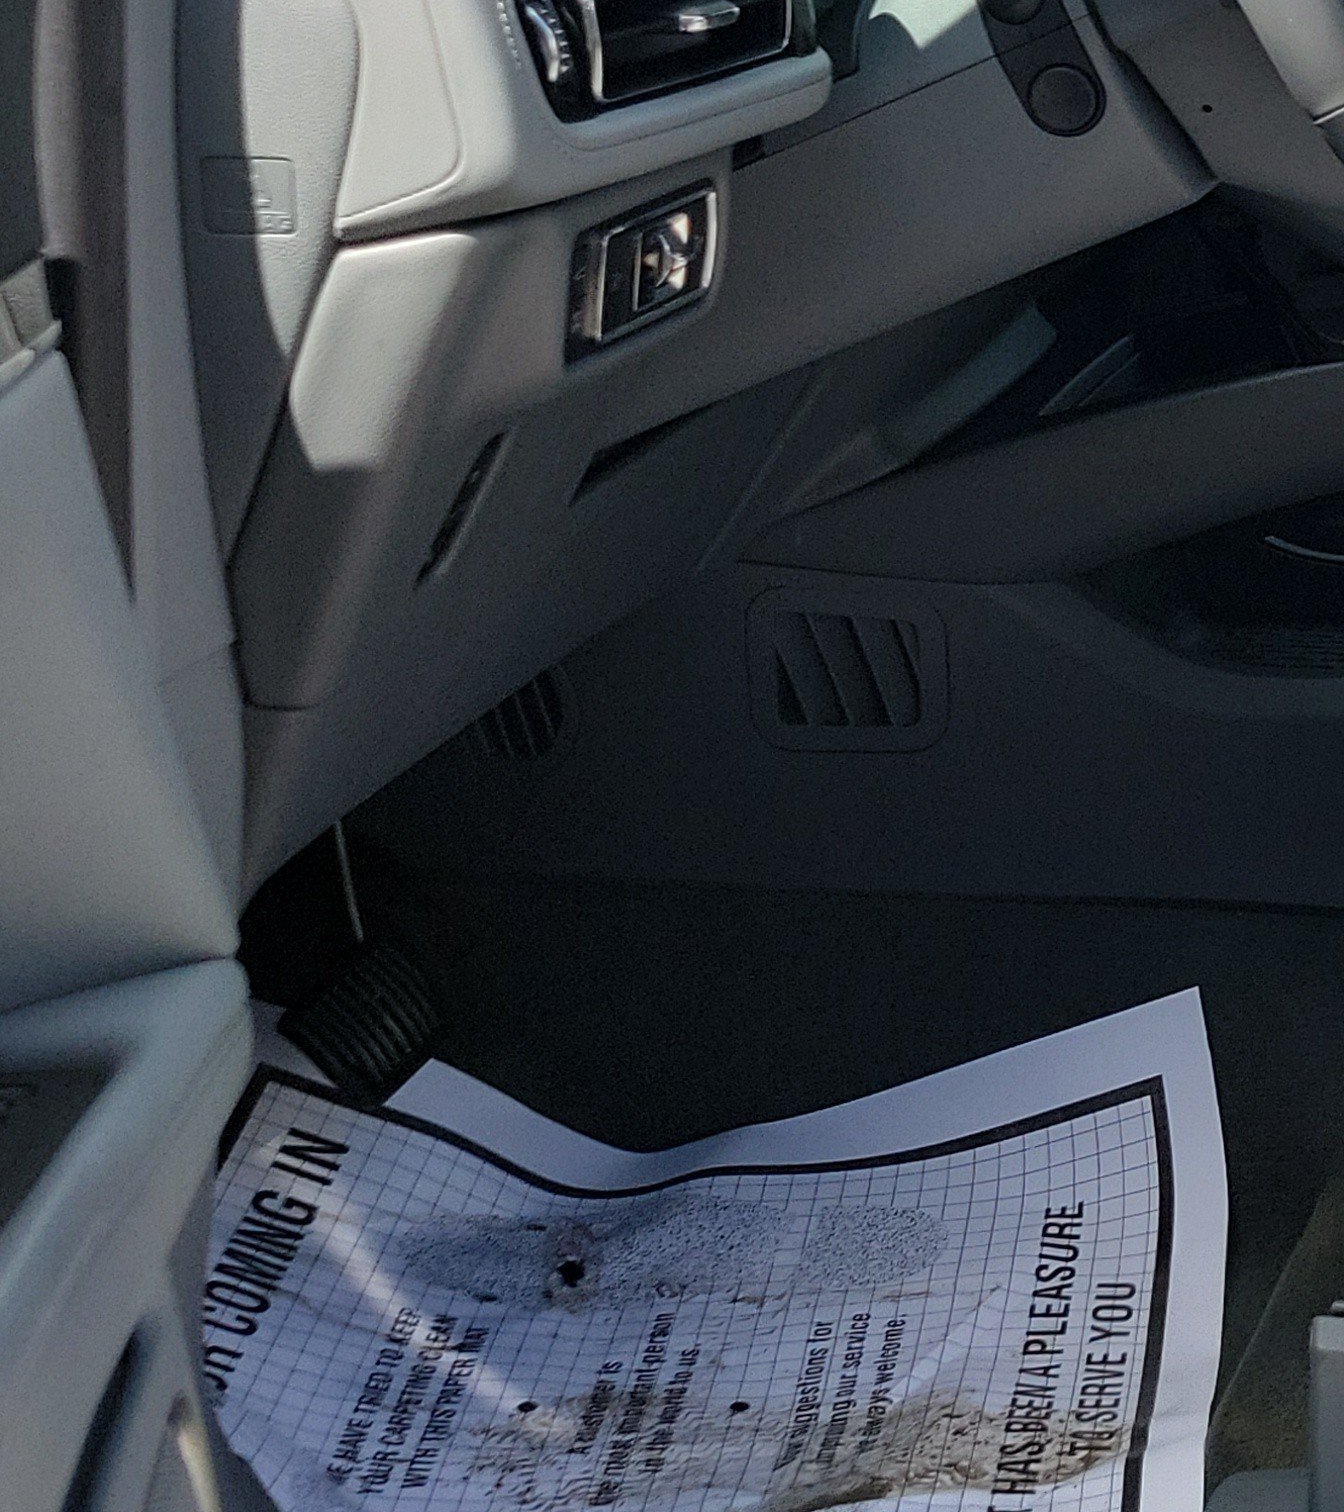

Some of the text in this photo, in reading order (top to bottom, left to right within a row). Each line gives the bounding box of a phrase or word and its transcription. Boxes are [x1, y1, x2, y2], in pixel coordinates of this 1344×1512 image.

[204, 1190, 319, 1337] COMING
[271, 1127, 350, 1186] IN
[1023, 1200, 1085, 1357] PLEASURE
[643, 1311, 676, 1364] person
[679, 1343, 701, 1368] us.
[807, 1321, 835, 1345] for
[842, 1312, 871, 1369] service
[872, 1313, 908, 1383] welcome.
[433, 1355, 478, 1407] PAPER
[599, 1360, 622, 1375] is
[791, 1346, 829, 1439] suggestions
[838, 1372, 858, 1396] our
[1018, 1363, 1062, 1379] A
[1068, 1281, 1137, 1457] TO SERVE YOU
[333, 1416, 375, 1464] HAVE
[355, 1371, 391, 1414] TRIED
[375, 1348, 402, 1369] TO
[358, 1313, 459, 1495] YOUR CARPETING CLEAN
[420, 1405, 457, 1447] THIS
[1005, 1378, 1058, 1433] BEEN
[400, 1446, 441, 1489] WITH
[991, 1440, 1045, 1495] HAS
